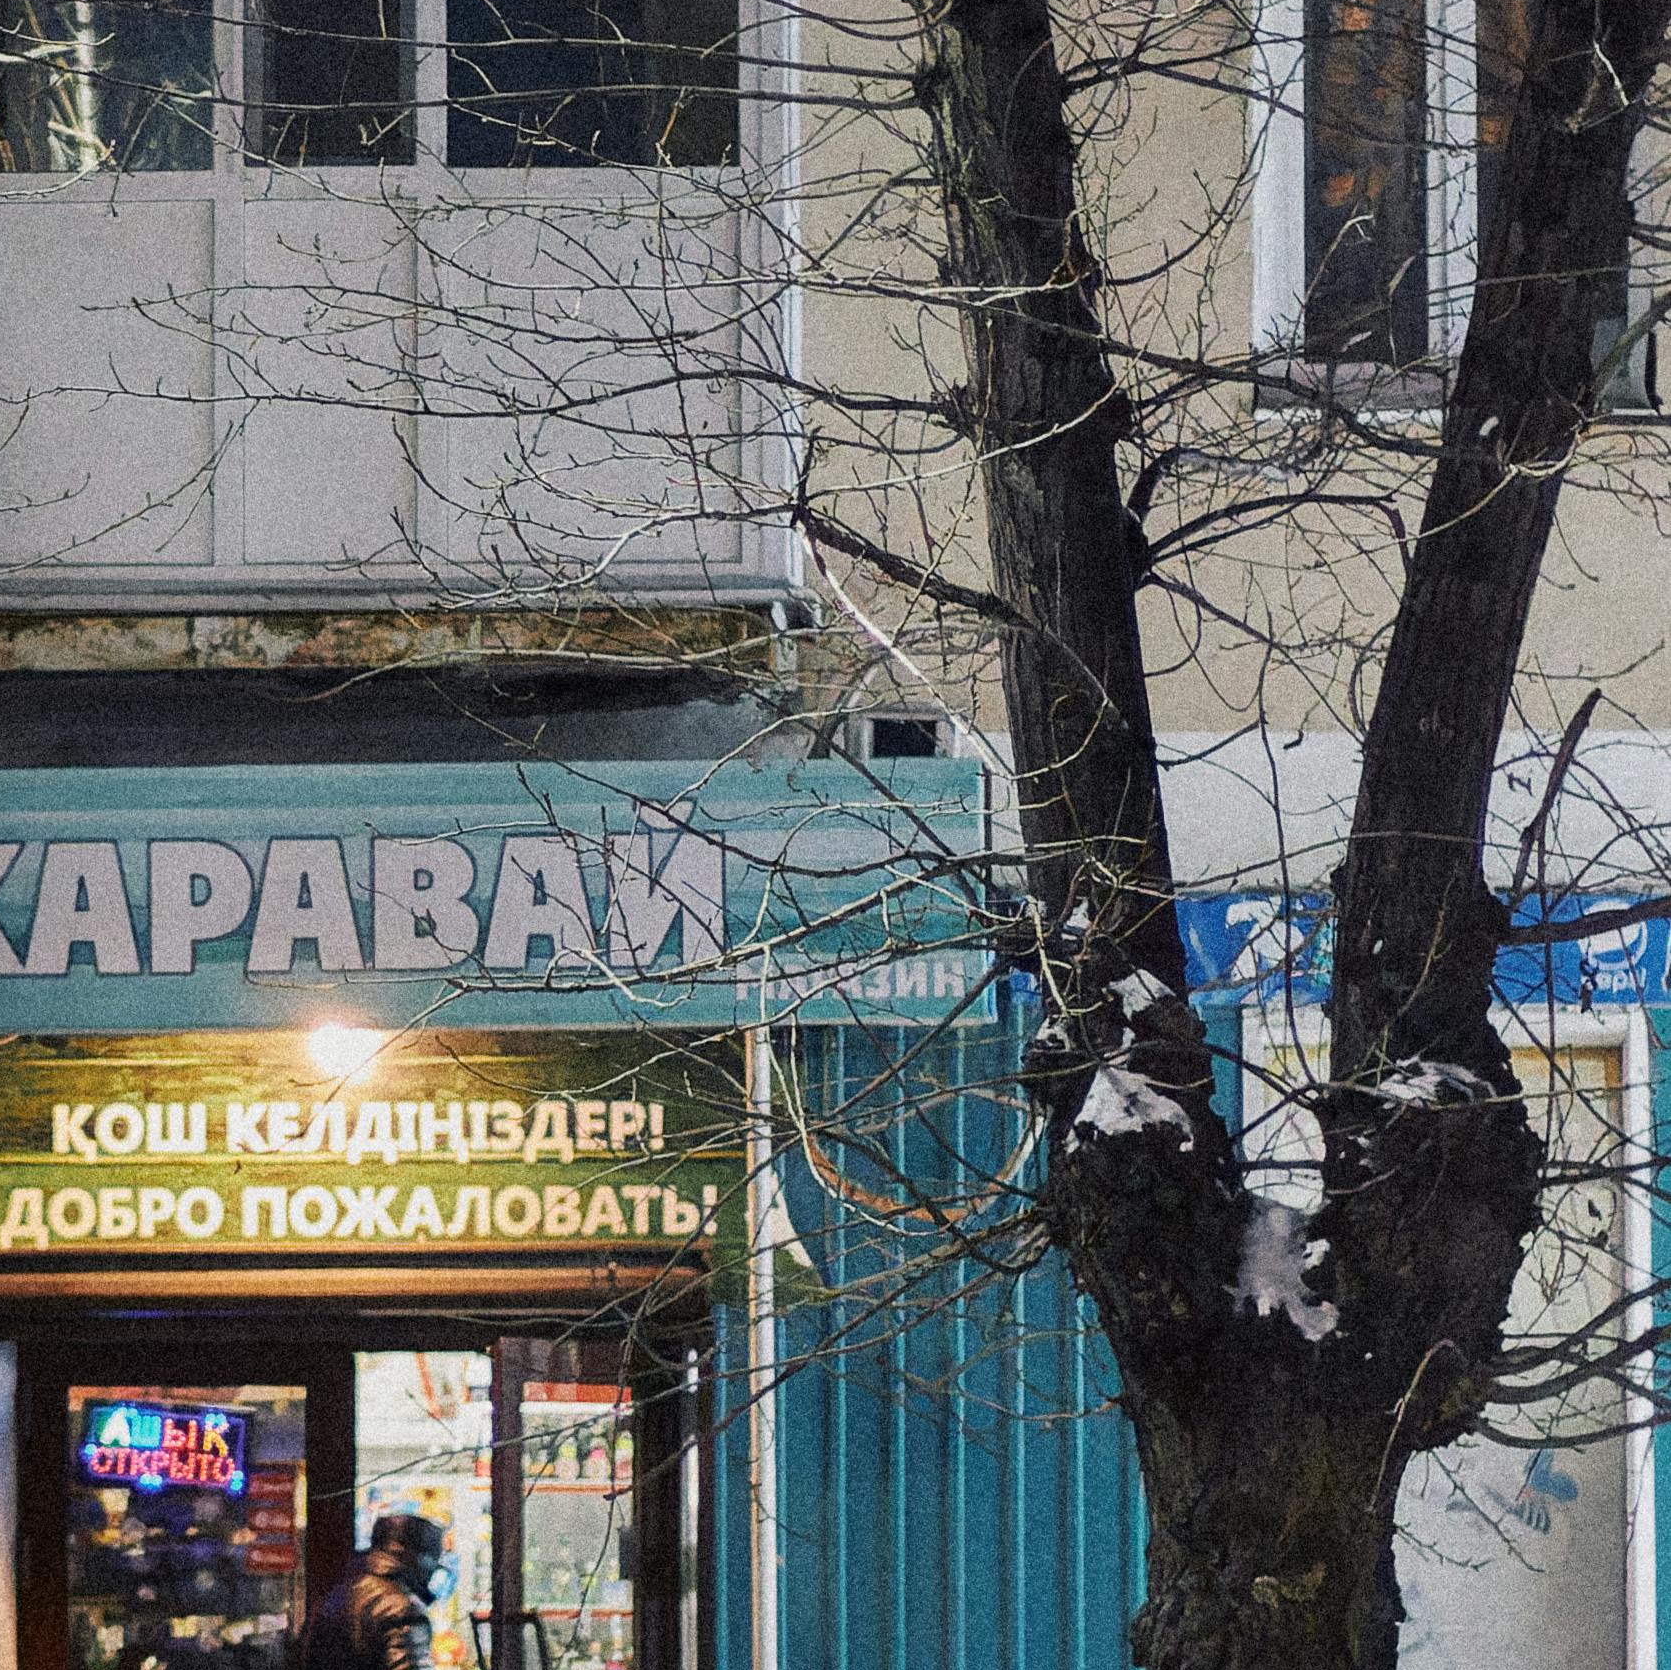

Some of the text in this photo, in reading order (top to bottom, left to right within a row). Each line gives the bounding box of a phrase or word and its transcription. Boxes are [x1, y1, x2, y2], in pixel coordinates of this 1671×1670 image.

[51, 1099, 666, 1164] ҚОШ КЕЛДІҢІЗДЕР!
[242, 1183, 719, 1241] ПОЖАЛОВАТЬ!
[90, 1445, 237, 1486] ОТКРЫТО
